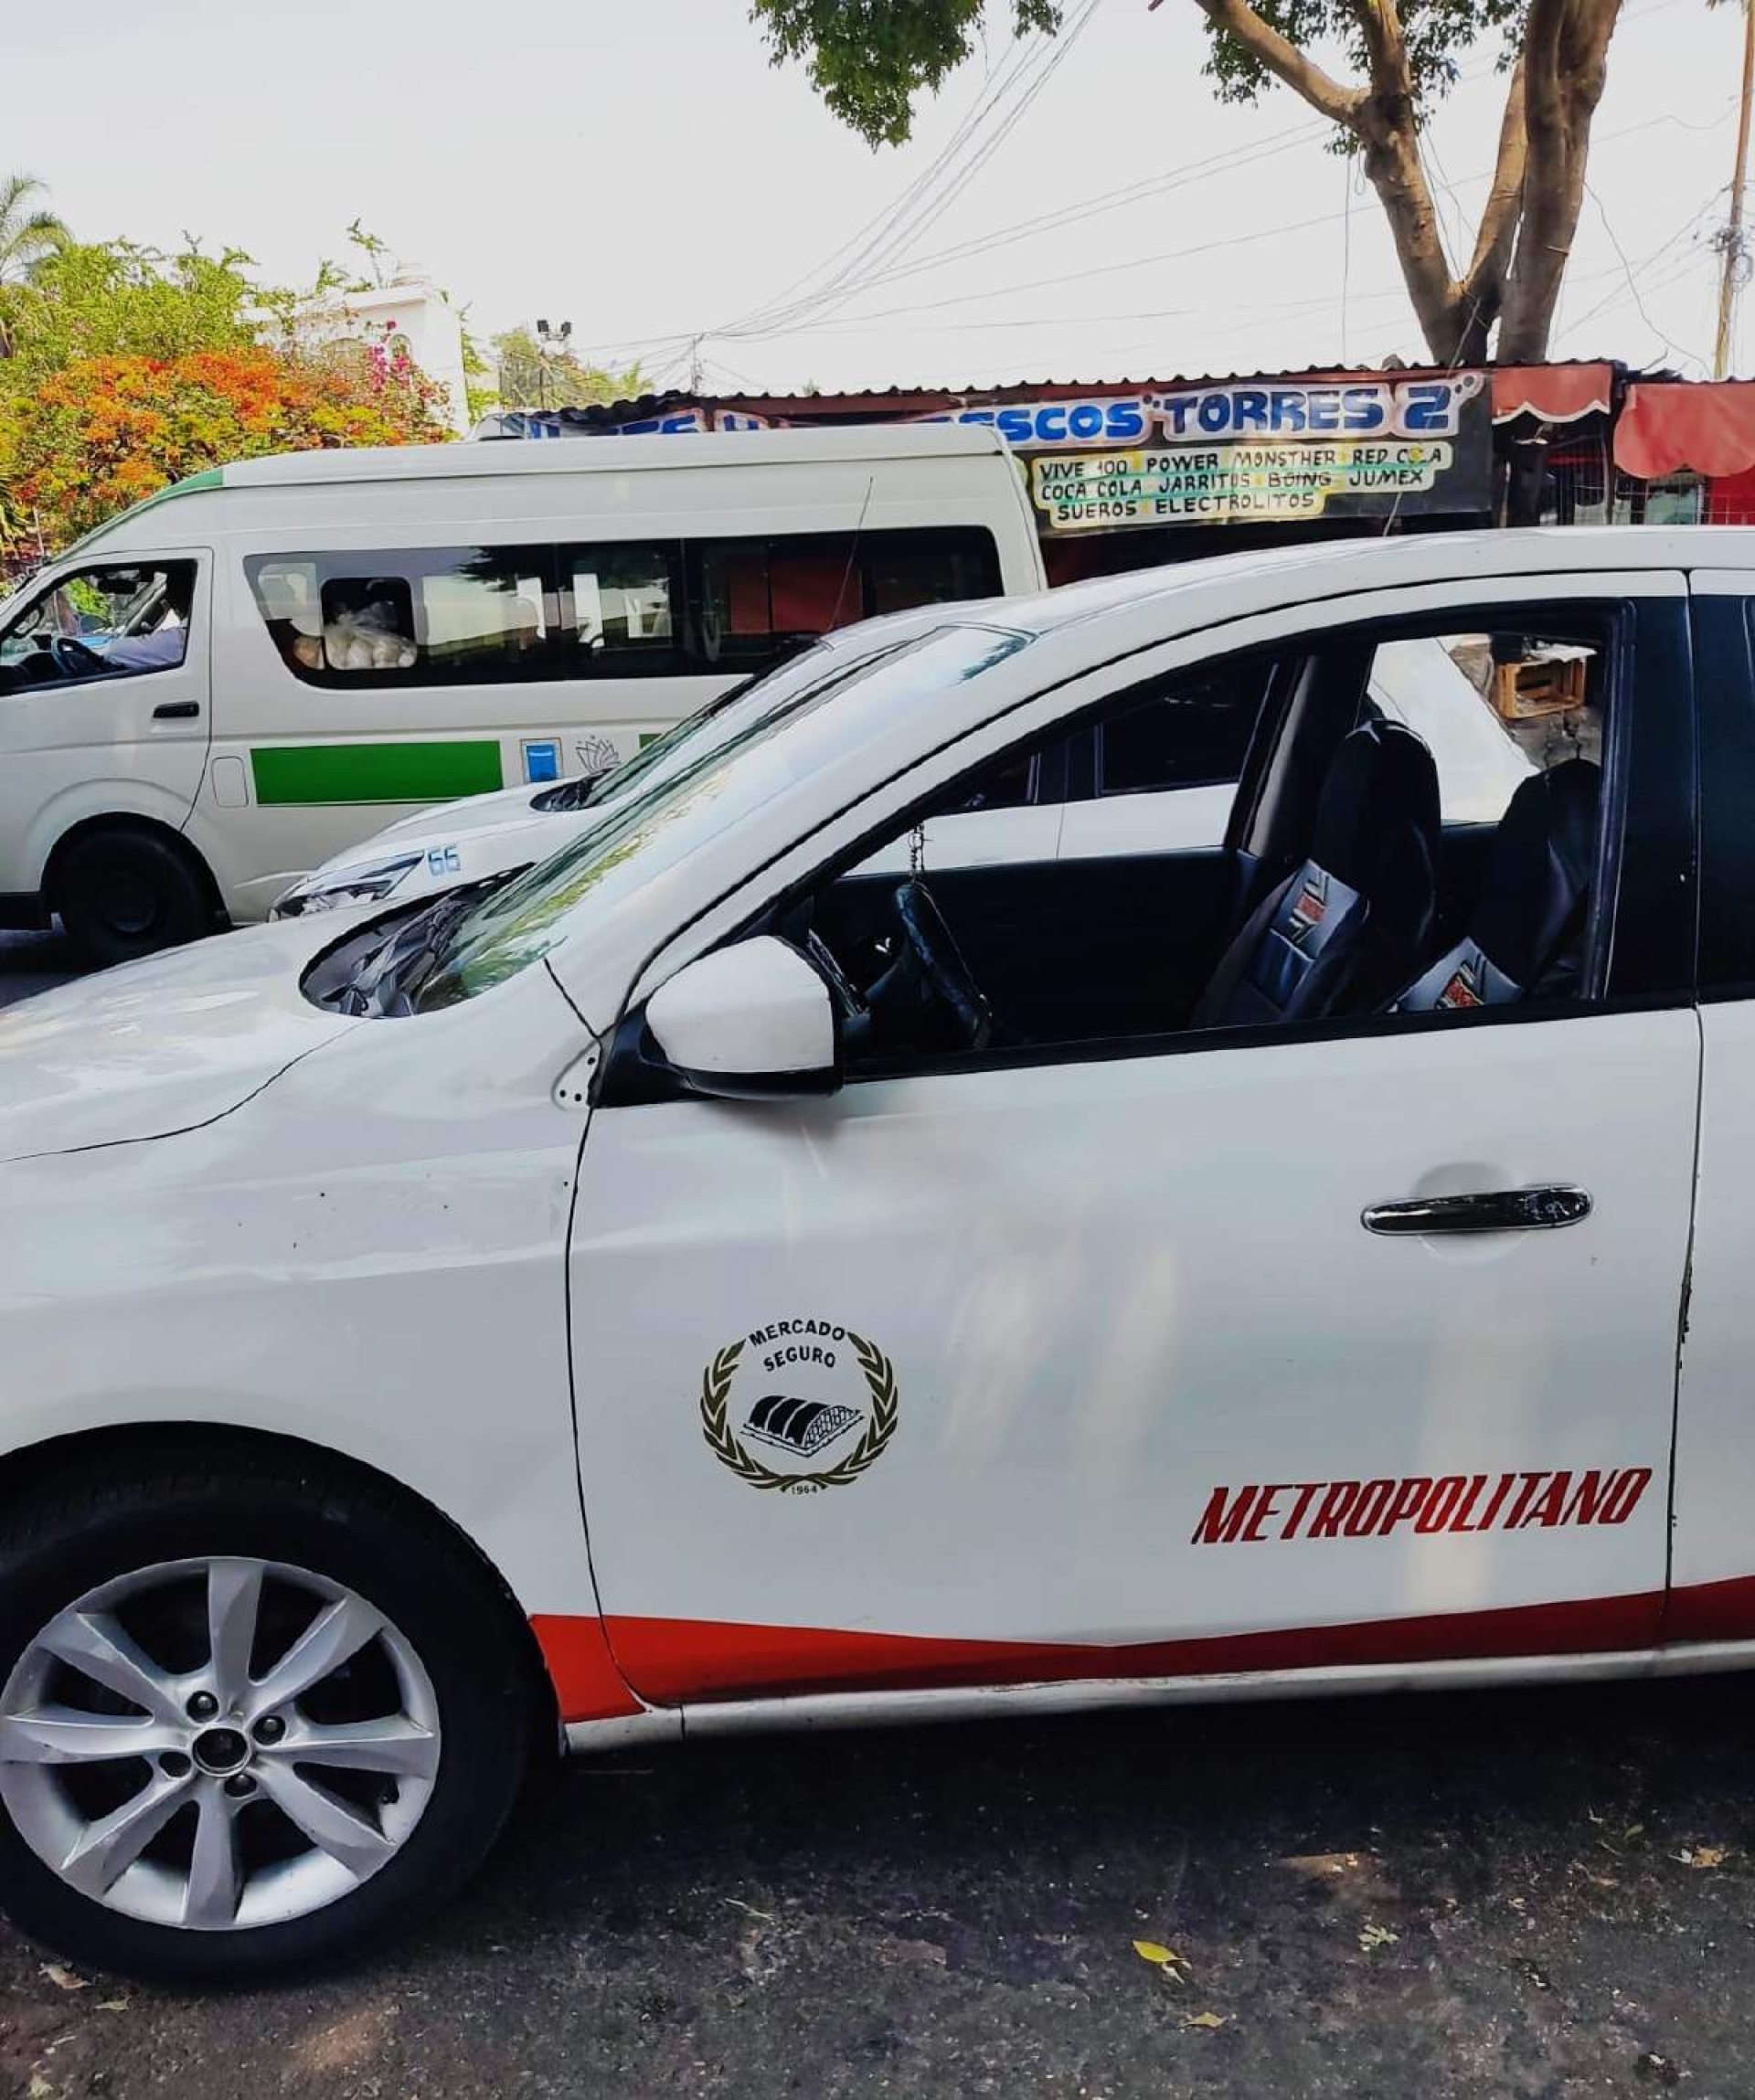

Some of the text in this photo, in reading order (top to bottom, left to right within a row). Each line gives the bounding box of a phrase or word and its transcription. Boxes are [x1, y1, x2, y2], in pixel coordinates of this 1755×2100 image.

[1039, 461, 1085, 481] VIVE
[1098, 460, 1128, 475] 100
[1146, 452, 1218, 474] POWER
[1232, 449, 1335, 469] MONSTHER
[1353, 448, 1388, 466] RED
[1042, 483, 1086, 501] COCA
[1098, 479, 1142, 498] COLA
[1269, 472, 1332, 488] BOING
[1349, 469, 1423, 486] JUMEX
[1058, 492, 1314, 521] SUEROS ELECTROLITOS
[428, 843, 462, 875] 66
[748, 1319, 846, 1347] MERCADO
[762, 1345, 837, 1373] SEGURO
[1190, 1468, 1653, 1545] METROPOLITANO
